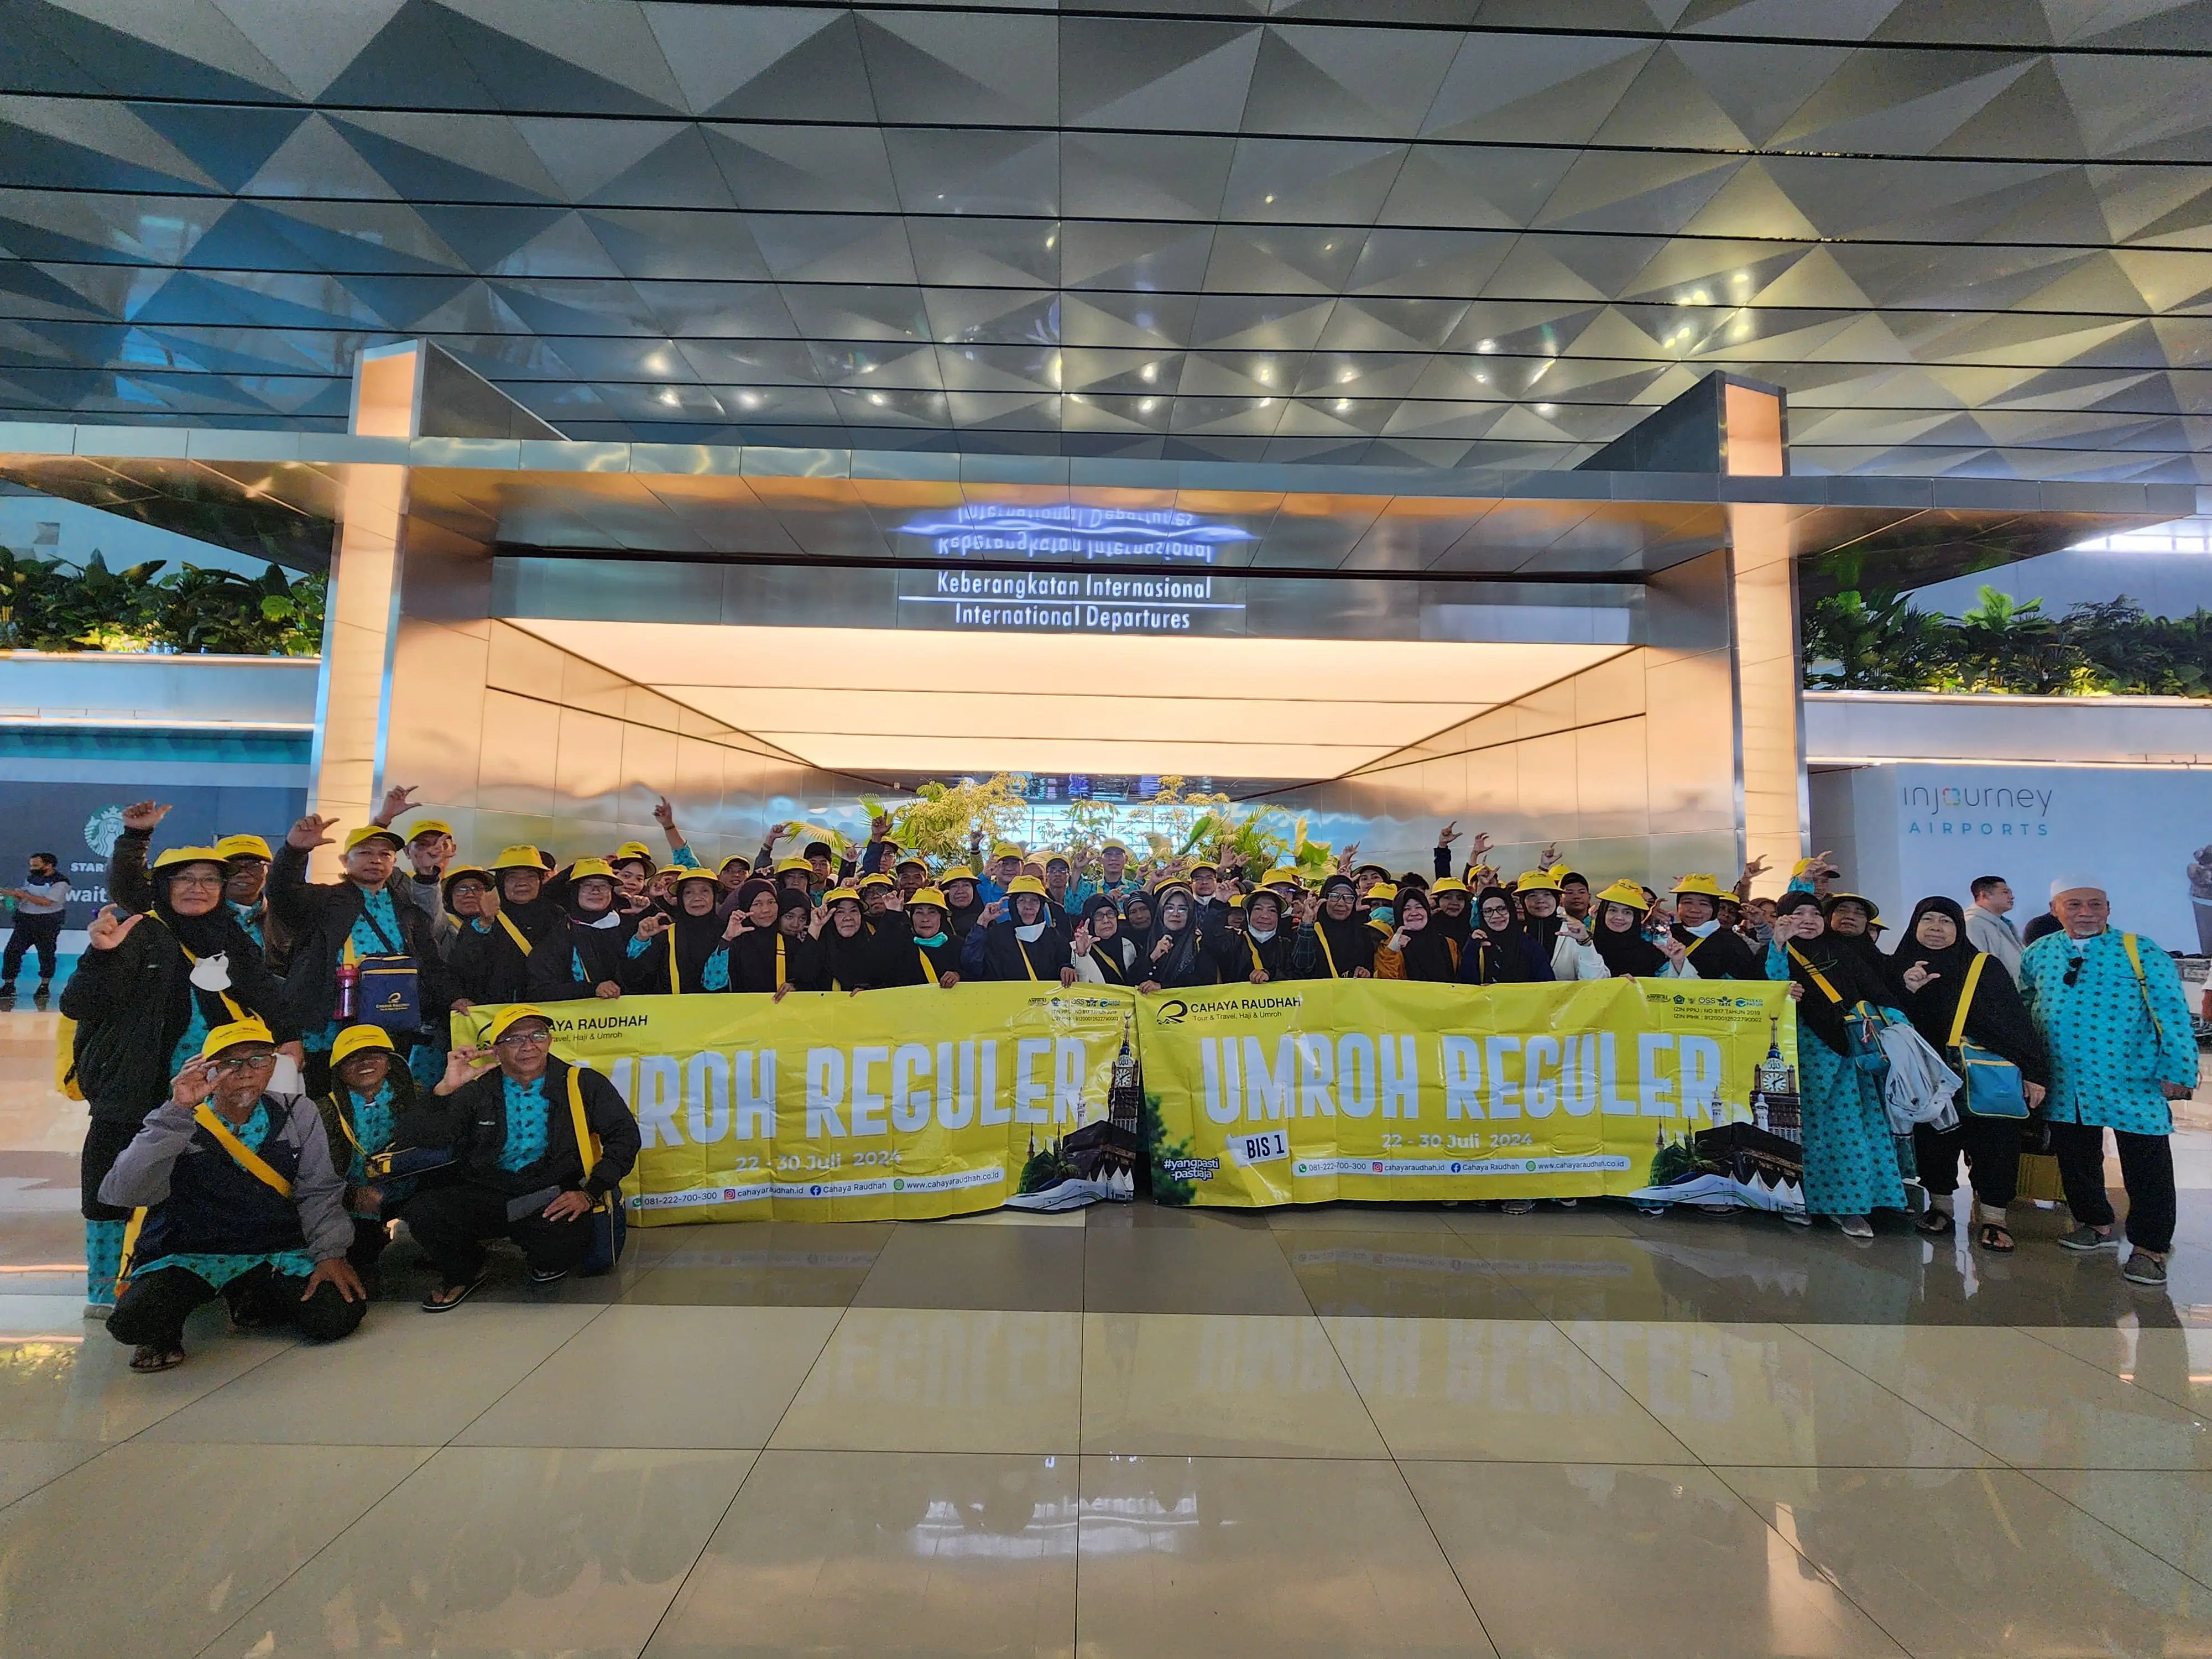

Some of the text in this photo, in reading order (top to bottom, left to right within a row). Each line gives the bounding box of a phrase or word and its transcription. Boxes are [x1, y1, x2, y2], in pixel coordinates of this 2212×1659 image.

[937, 571, 1211, 599] Keberangkatan Internasional
[956, 603, 1190, 631] International Departures
[1909, 822, 2048, 836] AIRPORTS
[70, 862, 107, 872] STAR
[65, 885, 107, 902] wait
[1191, 997, 1301, 1014] CAHAYA RAUDHAH
[578, 1015, 648, 1030] RAUDHAH
[1239, 1012, 1252, 1020] Haji
[573, 1034, 587, 1042] Haji
[597, 1031, 622, 1040] Umroh
[1201, 1032, 1723, 1125] UMROH REGULER
[806, 1038, 1089, 1139] REGULER
[1246, 1135, 1285, 1159] BIS 1
[1381, 1134, 1403, 1147] 22
[1419, 1134, 1442, 1147] 30
[1447, 1133, 1480, 1148] Juli
[1490, 1133, 1533, 1147] 2024
[735, 1156, 760, 1172] 22
[776, 1155, 801, 1171] 30
[805, 1152, 842, 1171] Juli
[852, 1149, 902, 1166] 2024
[1164, 1157, 1219, 1170] #yangpasti
[1309, 1162, 1366, 1171] 081-222-700-300
[1384, 1163, 1445, 1173] cahayaraudhah.id
[1462, 1164, 1489, 1172] Cahaya
[644, 1192, 717, 1206] 081-222-700-300
[823, 1184, 852, 1194] Cahaya
[854, 1182, 887, 1191] Raudhah
[906, 1171, 999, 1189] www.cahayaraudhah.co.id
